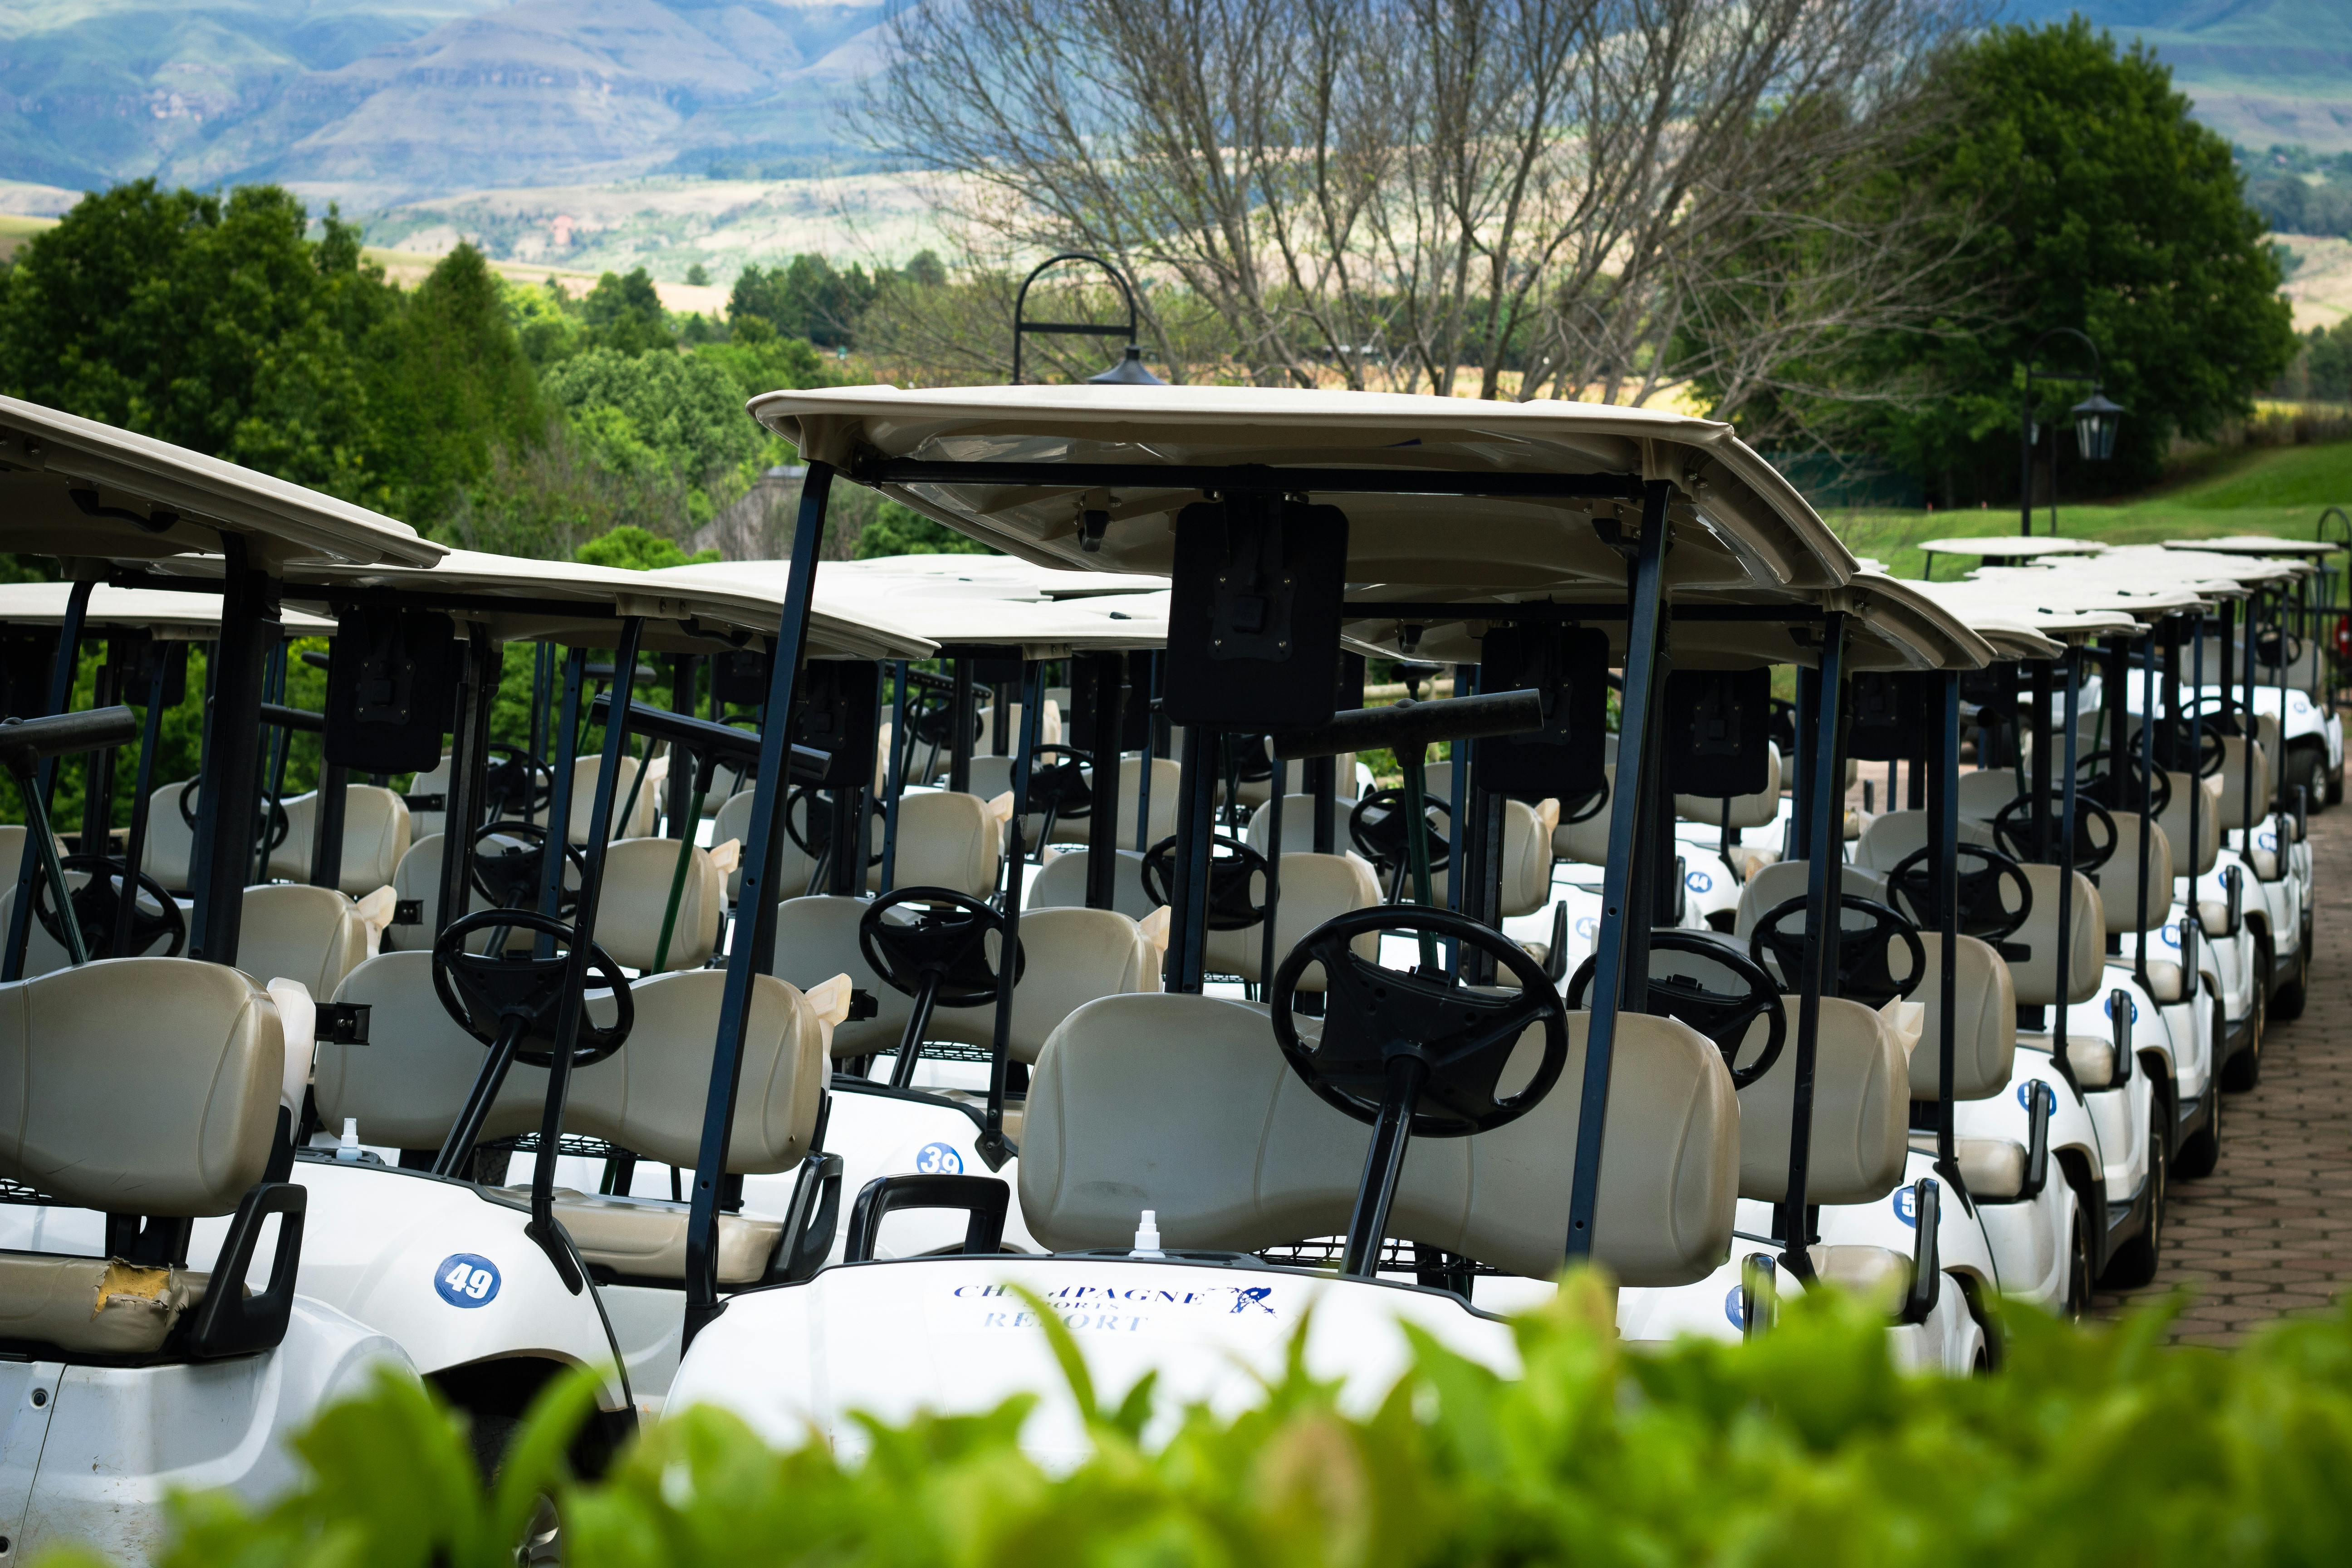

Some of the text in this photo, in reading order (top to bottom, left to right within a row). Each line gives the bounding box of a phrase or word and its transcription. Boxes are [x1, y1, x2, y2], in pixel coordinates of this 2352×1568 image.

[1689, 873, 1709, 891] 44
[921, 1146, 960, 1174] 39
[445, 1263, 493, 1299] 49
[984, 1312, 1148, 1331] REORT
